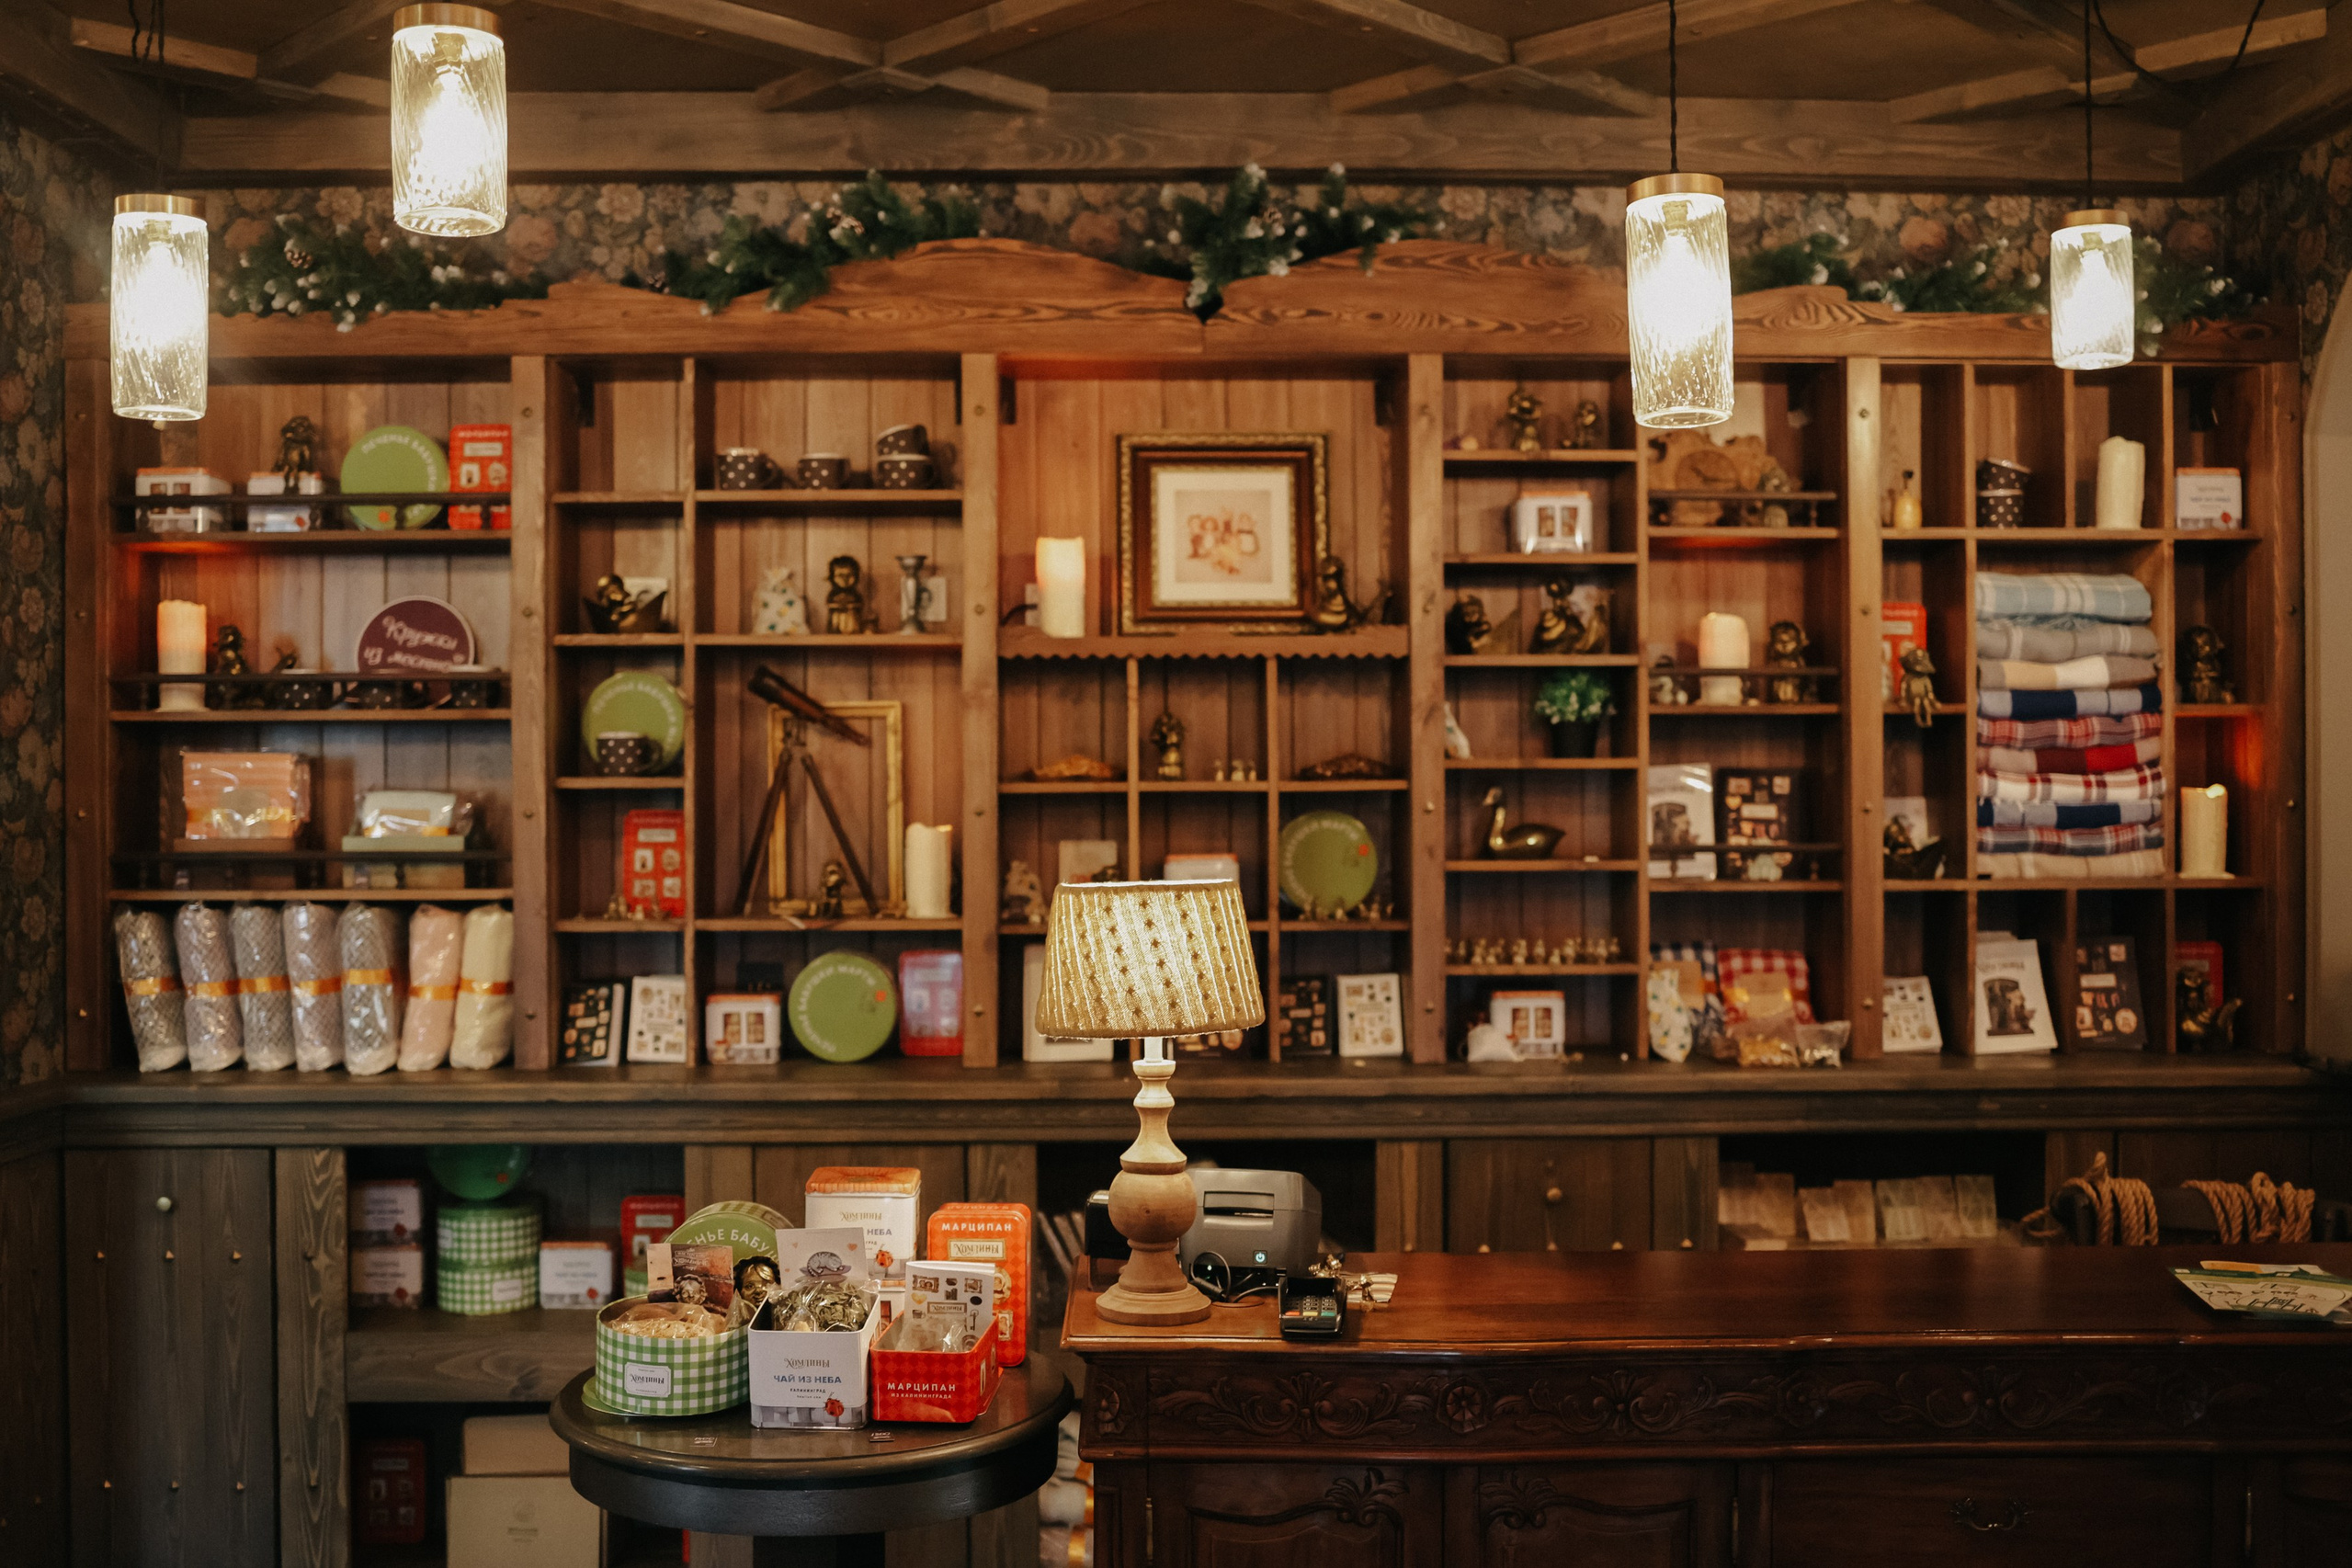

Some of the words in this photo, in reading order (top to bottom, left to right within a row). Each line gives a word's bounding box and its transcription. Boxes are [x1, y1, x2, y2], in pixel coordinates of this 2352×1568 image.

[866, 1228, 892, 1236] НЕБА
[941, 1222, 1013, 1233] МАРЦИПАН
[773, 1374, 796, 1383] ЧАЙ
[798, 1375, 812, 1384] ИЗ
[814, 1376, 842, 1384] НЕБА
[887, 1382, 956, 1392] МАРЦИПАН
